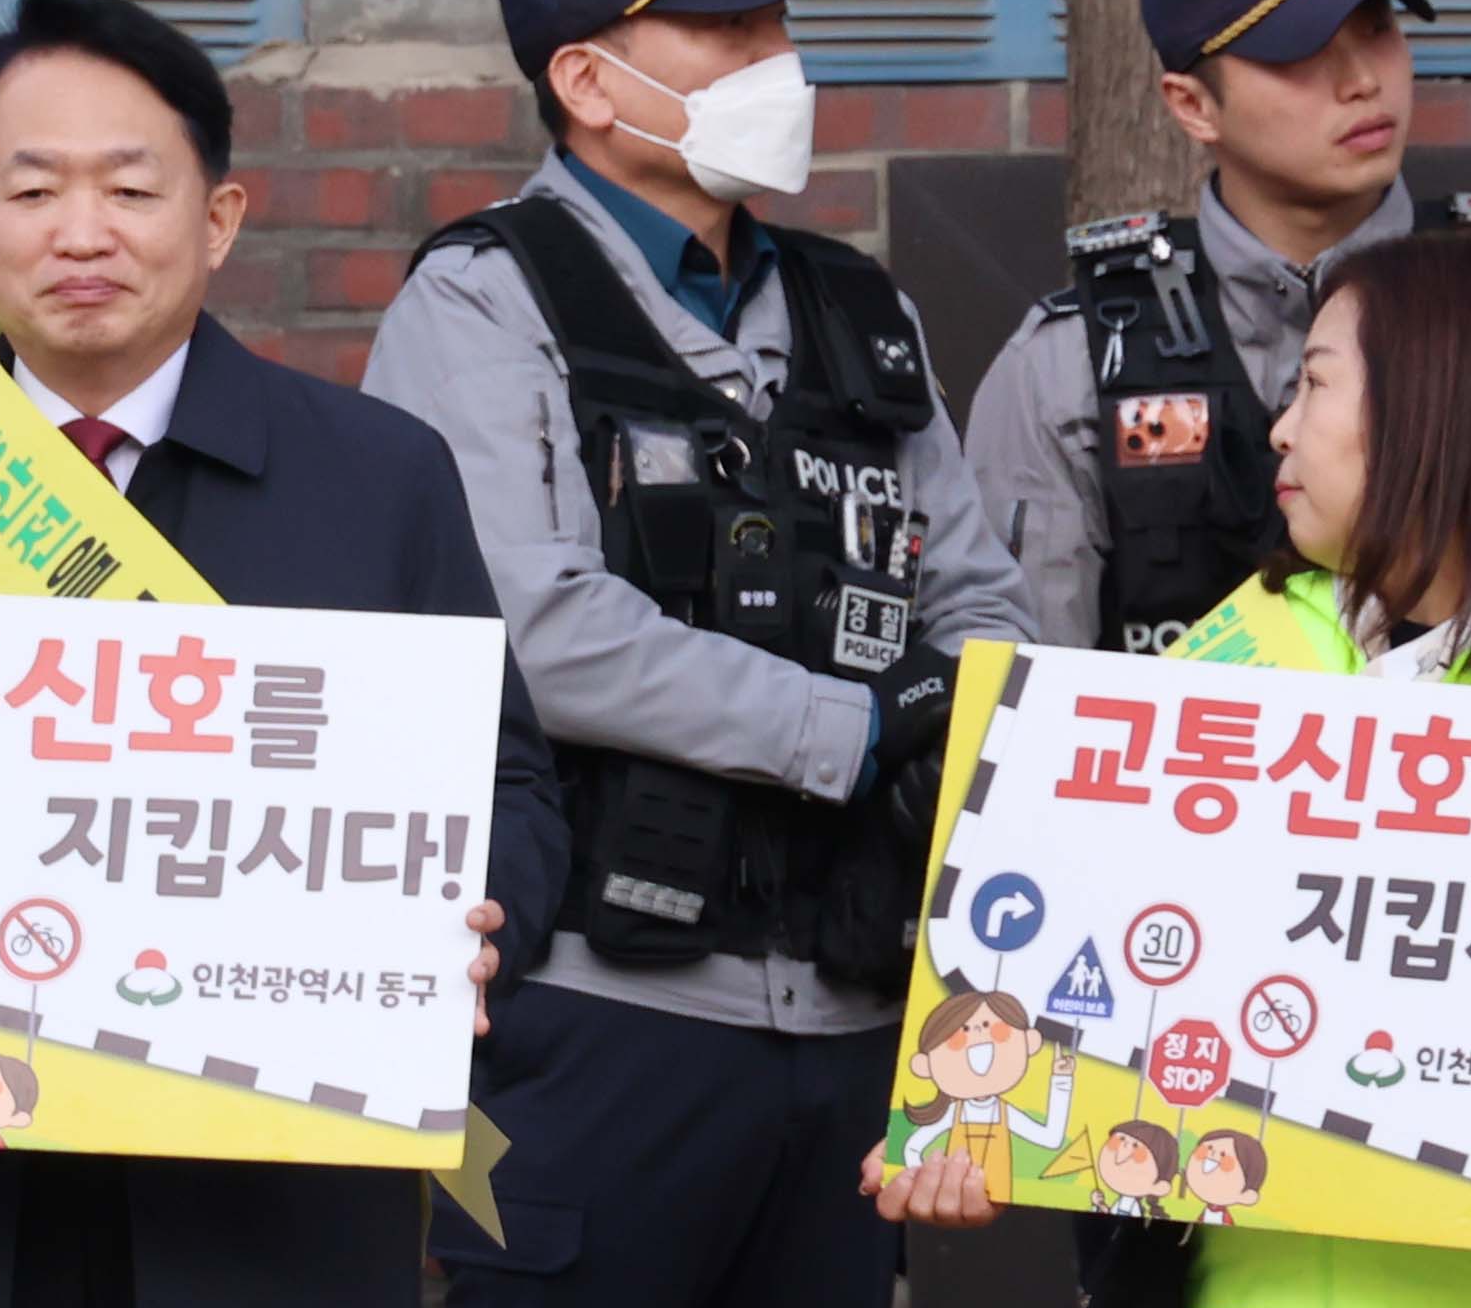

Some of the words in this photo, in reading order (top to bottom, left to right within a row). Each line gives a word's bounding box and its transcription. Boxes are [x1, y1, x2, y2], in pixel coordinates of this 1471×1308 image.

[793, 448, 903, 510] POLICE
[897, 676, 946, 709] POLICE
[36, 796, 471, 901] 지킵시다!
[1142, 923, 1184, 959] 30
[191, 960, 366, 1006] 인천광역시
[374, 970, 439, 1009] 동구
[1160, 1064, 1216, 1093] STOP
